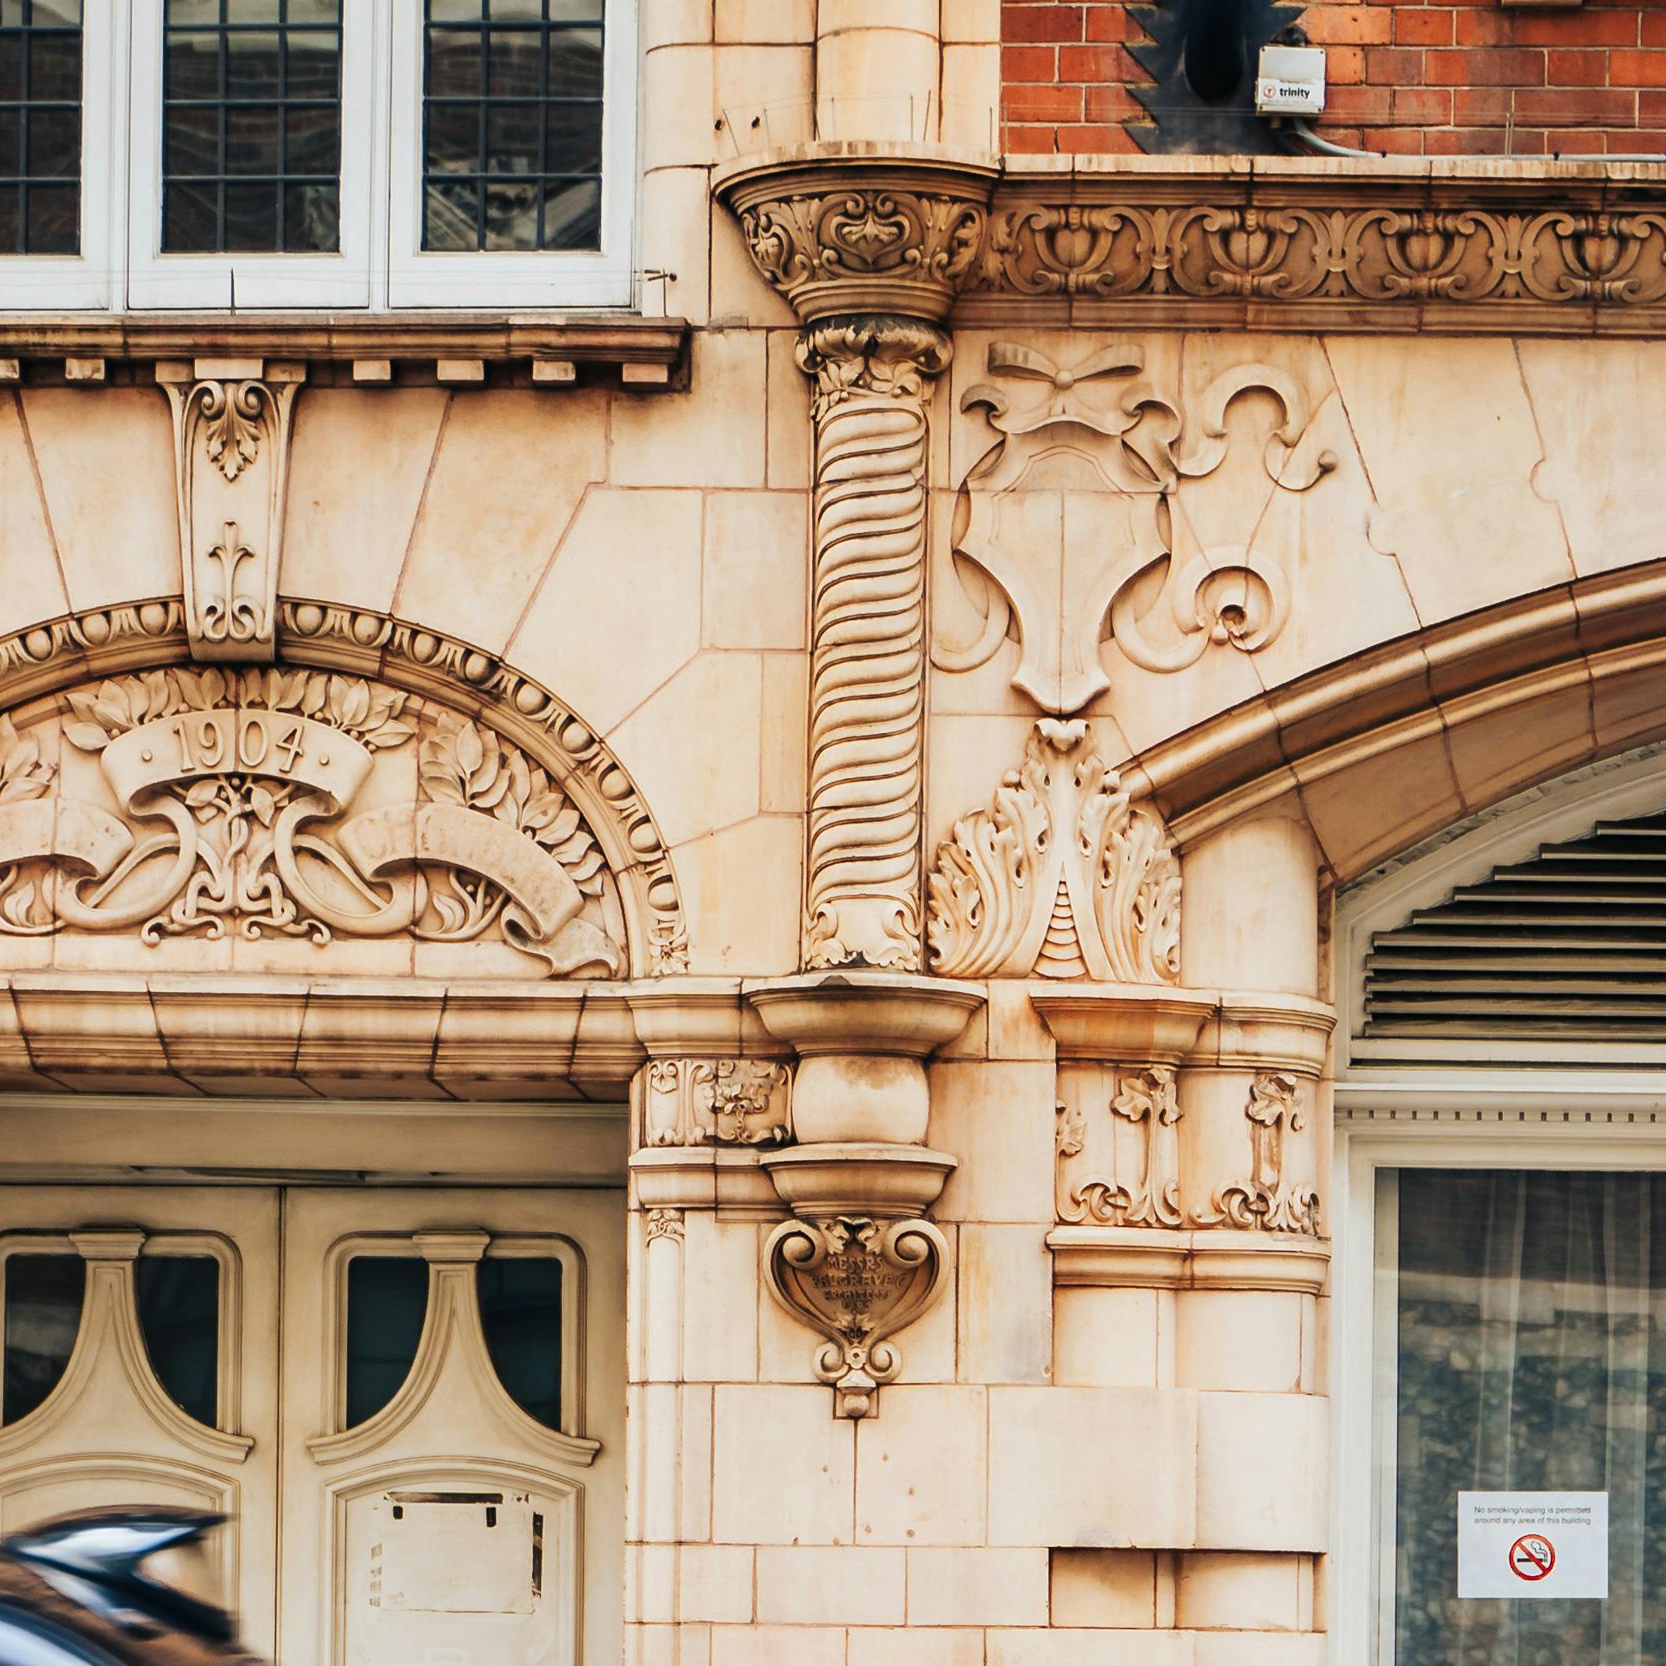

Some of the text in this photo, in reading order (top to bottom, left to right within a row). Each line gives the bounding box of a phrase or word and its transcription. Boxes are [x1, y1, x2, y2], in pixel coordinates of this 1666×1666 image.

[1279, 87, 1310, 99] trinity
[172, 719, 305, 773] 1904
[1474, 1506, 1591, 1515] No smoking/vaping is permitted
[1474, 1517, 1501, 1525] around
[1503, 1518, 1516, 1526] any
[1537, 1517, 1545, 1525] of
[1546, 1517, 1560, 1525] this
[1561, 1517, 1592, 1526] building
